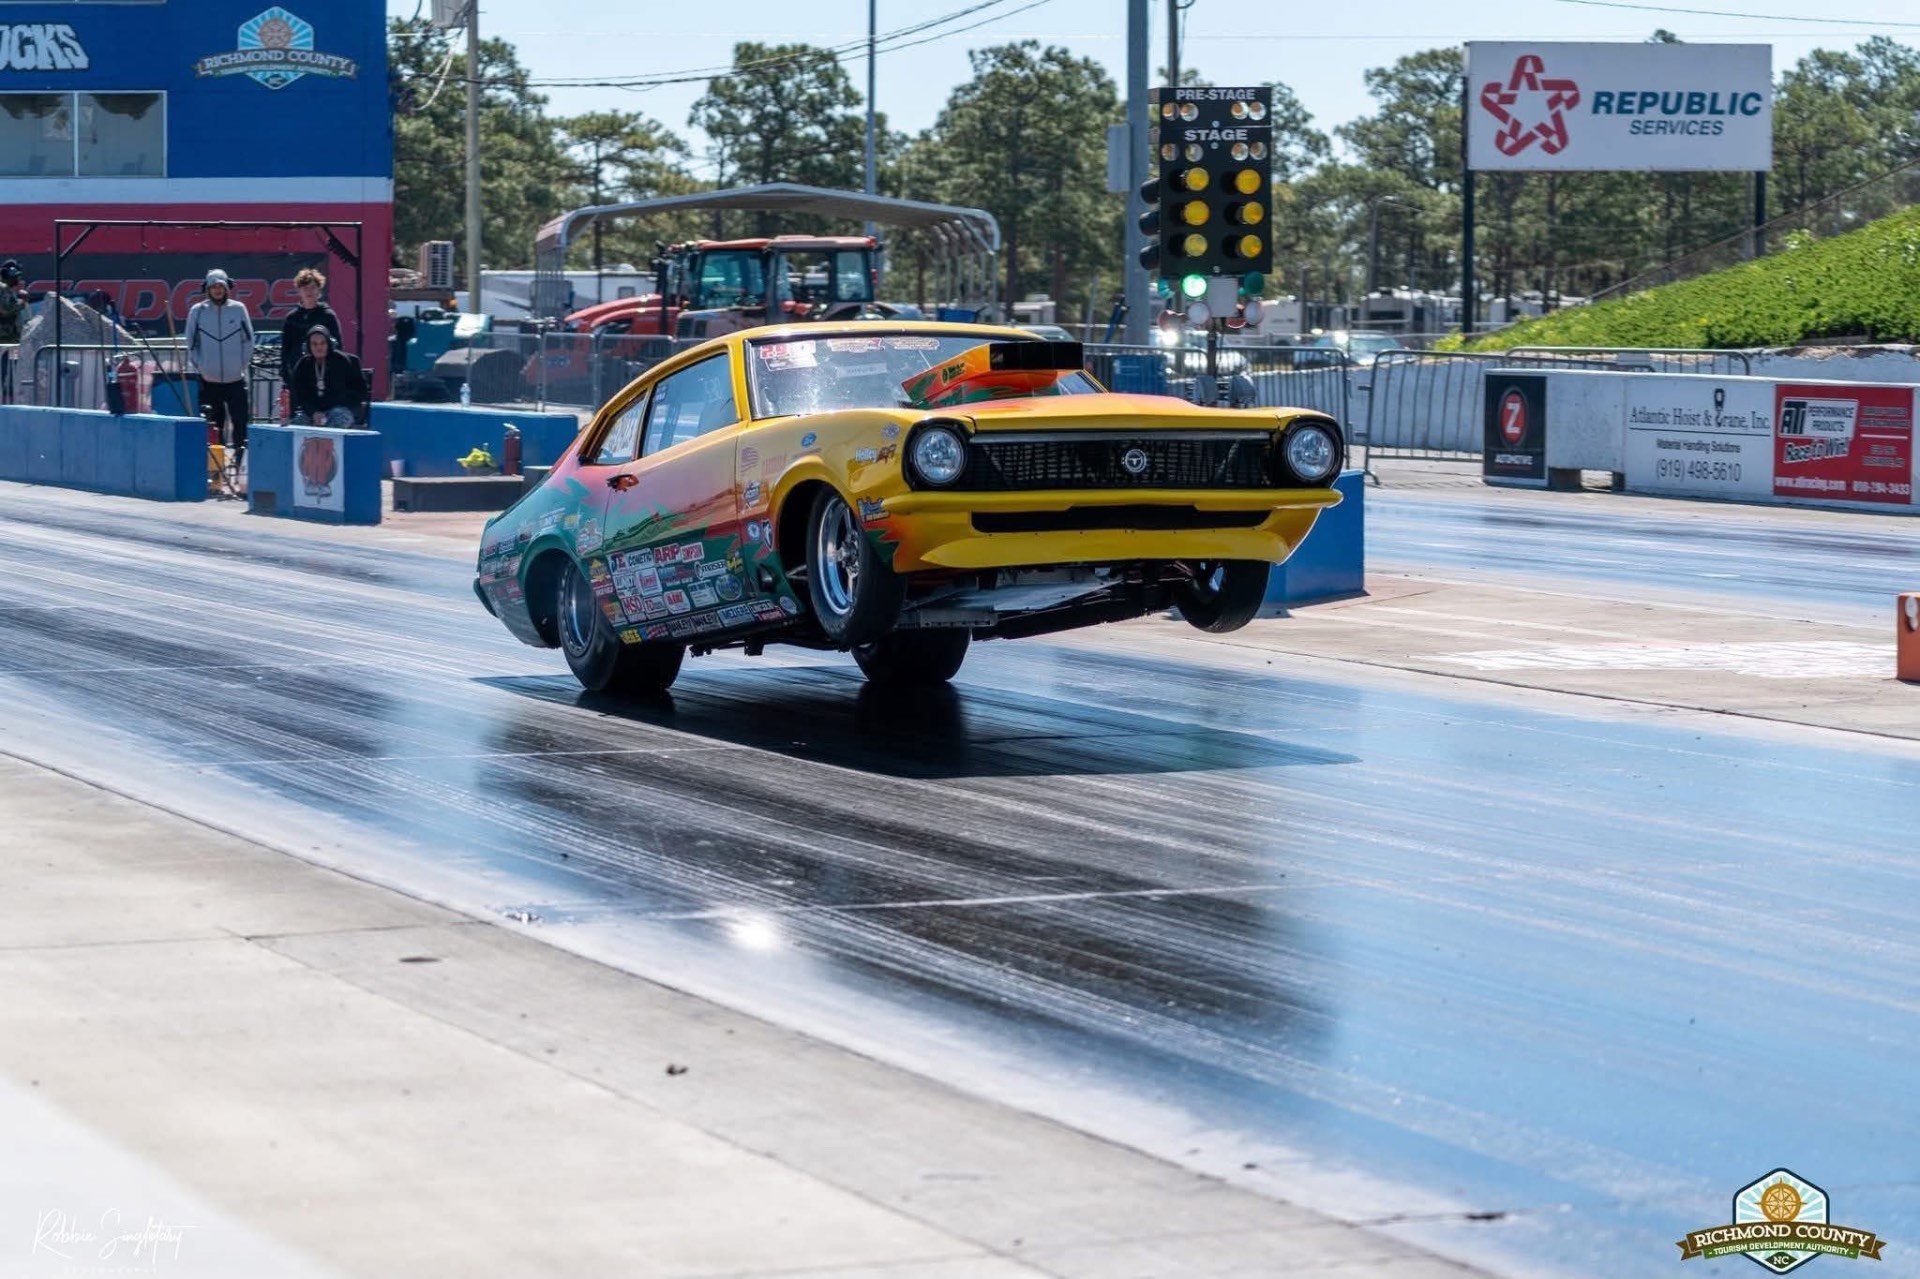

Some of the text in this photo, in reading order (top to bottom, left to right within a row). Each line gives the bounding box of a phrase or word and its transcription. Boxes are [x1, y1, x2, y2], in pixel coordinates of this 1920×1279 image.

[204, 50, 285, 69] RICHMOND
[287, 50, 351, 68] COUNTY
[1176, 89, 1255, 100] PRE-STAGE
[1591, 91, 1762, 116] REPUBLIC
[1184, 129, 1249, 141] STAGE
[1629, 120, 1724, 135] SERVICES
[1506, 402, 1521, 434] Z
[1630, 406, 1670, 425] Atlantic
[1673, 407, 1701, 426] Hoist
[1703, 409, 1713, 427] &
[1751, 410, 1770, 429] Inc.
[1808, 405, 1855, 418] PERFORMANCE
[1813, 420, 1846, 432] PRODUCTS
[1683, 440, 1711, 454] Handling
[1711, 441, 1741, 453] Solutions
[1785, 442, 1810, 462] Race
[1656, 458, 1742, 482] (919) 498-5610
[655, 545, 681, 564] ARP
[622, 595, 642, 614] MSD
